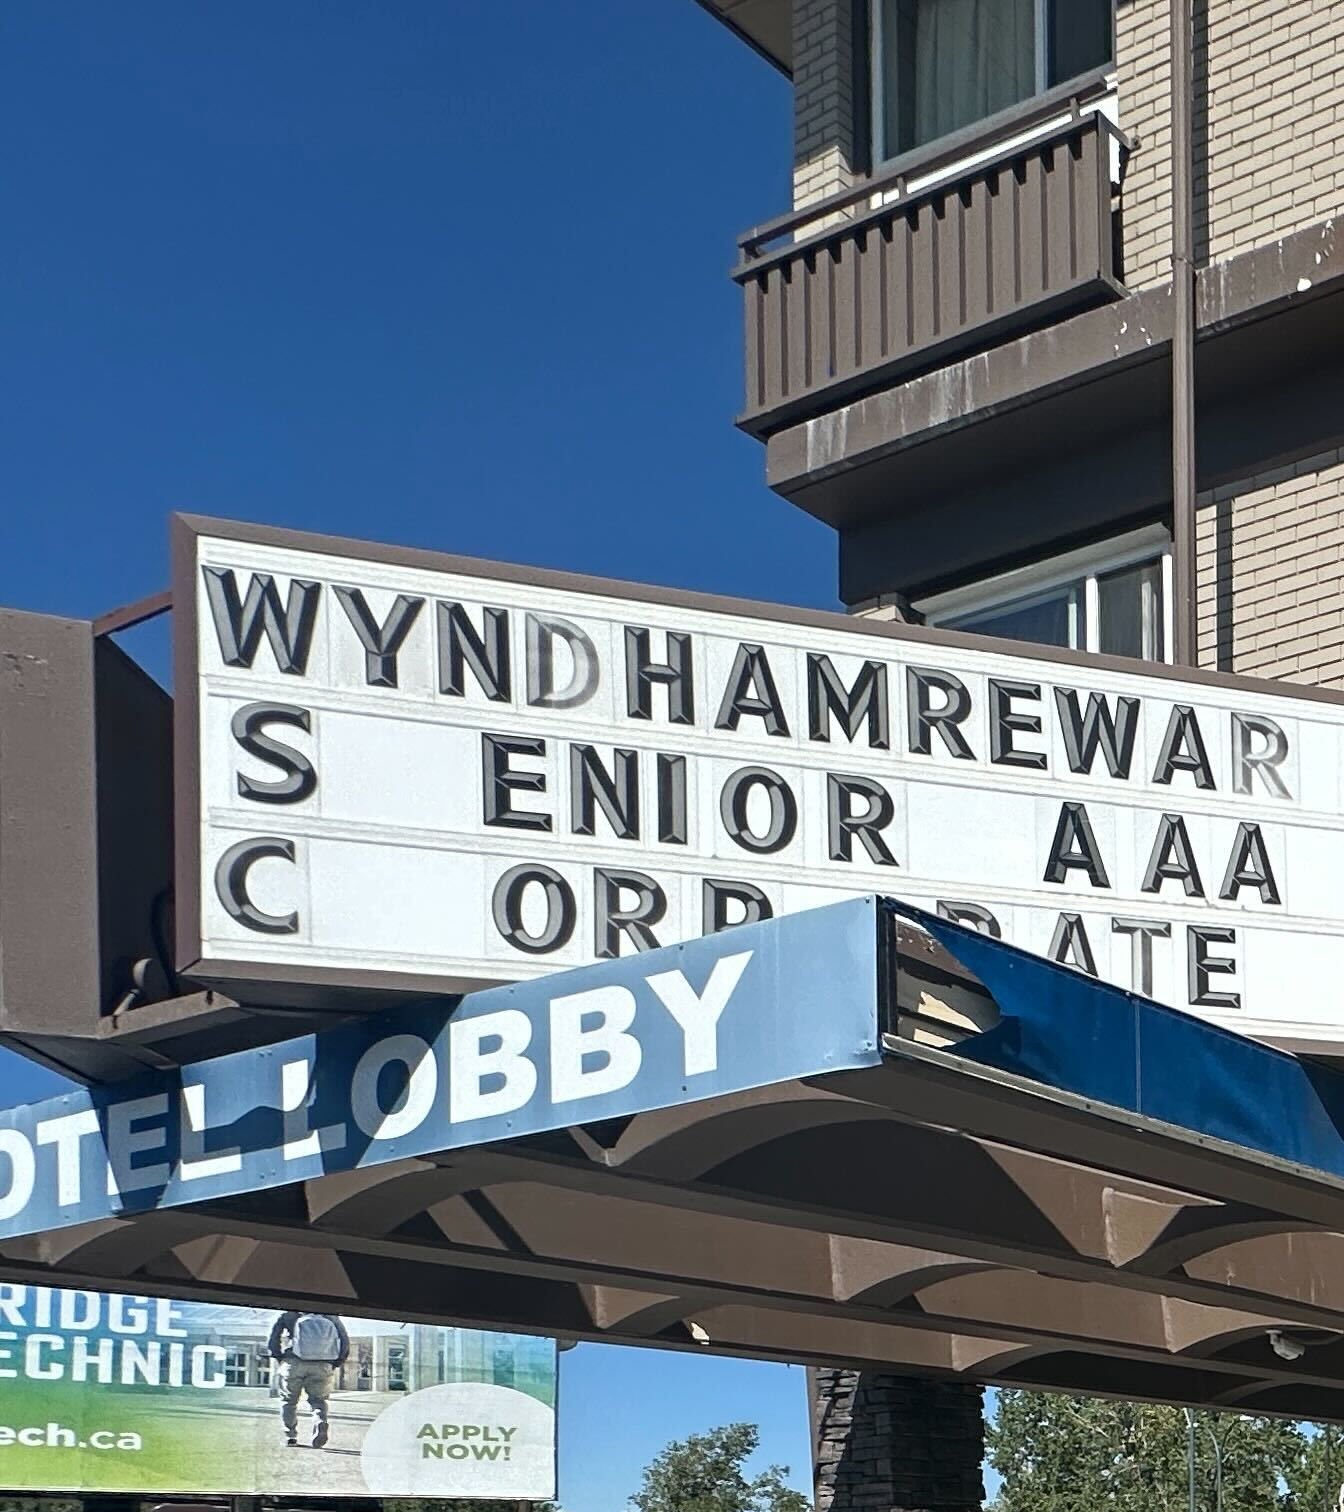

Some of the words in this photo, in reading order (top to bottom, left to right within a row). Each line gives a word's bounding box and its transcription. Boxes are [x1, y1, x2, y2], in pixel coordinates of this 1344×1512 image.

[281, 950, 755, 1161] LOBBY
[416, 1423, 517, 1442] APPLY
[422, 1442, 511, 1461] NOW!
